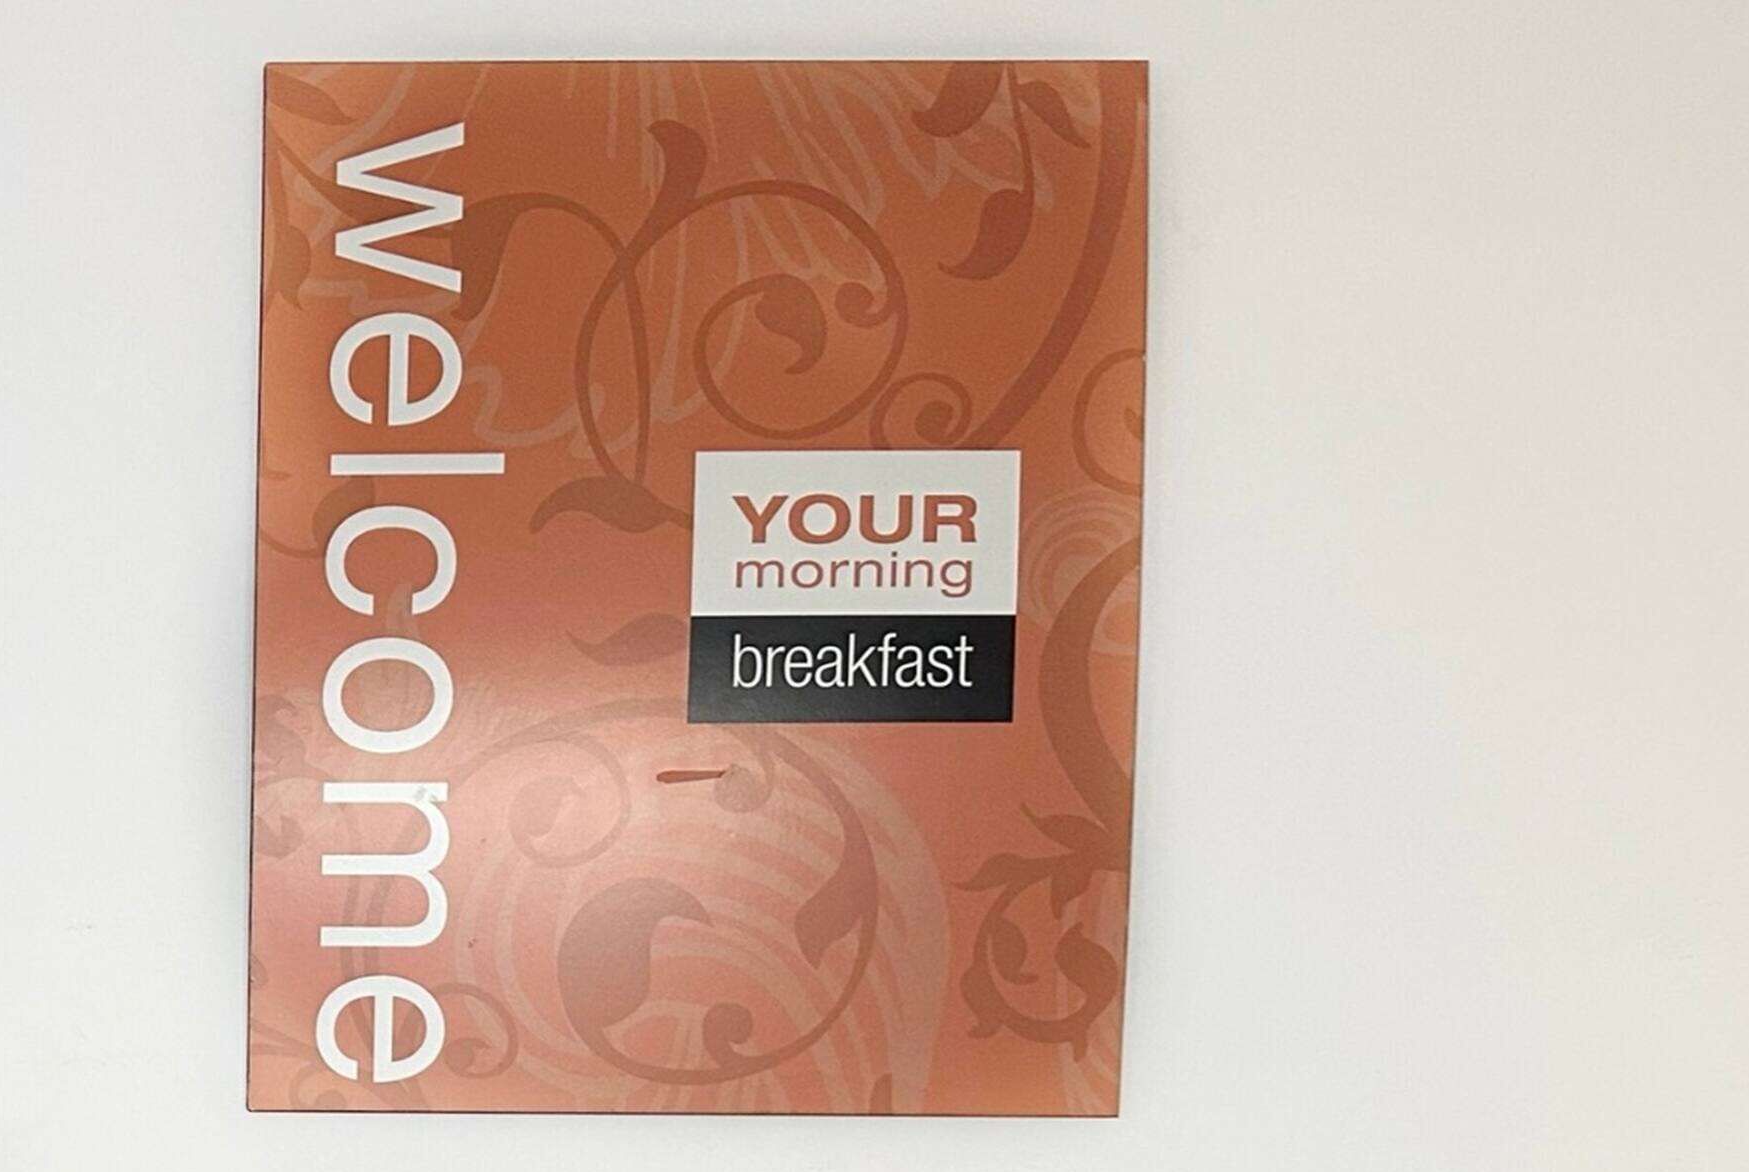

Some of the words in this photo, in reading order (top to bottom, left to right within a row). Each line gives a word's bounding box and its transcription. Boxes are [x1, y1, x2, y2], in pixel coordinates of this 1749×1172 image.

[733, 493, 978, 545] YOUR
[735, 553, 973, 597] morning
[316, 123, 505, 1084] welcome
[732, 632, 974, 689] breakfast
